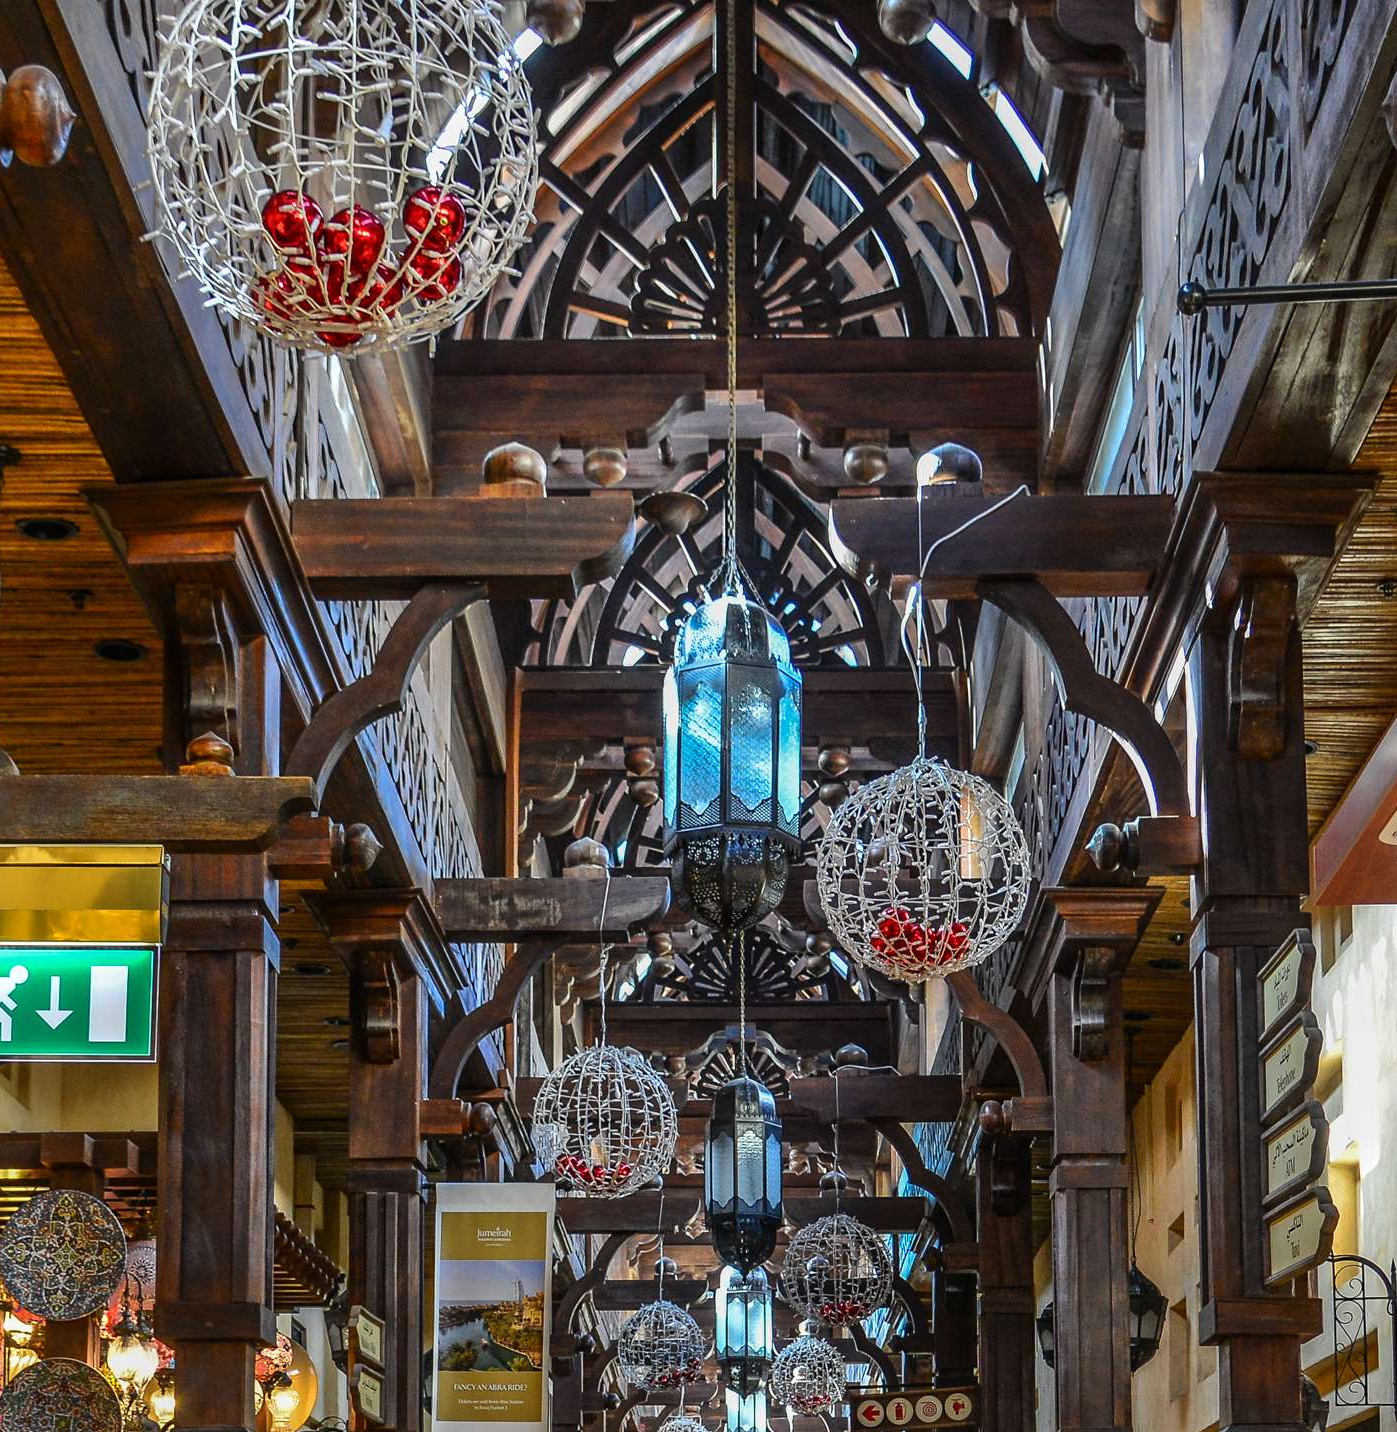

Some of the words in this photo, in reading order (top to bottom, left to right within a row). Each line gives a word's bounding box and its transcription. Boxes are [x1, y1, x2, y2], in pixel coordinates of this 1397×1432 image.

[1276, 1068, 1296, 1094] Telephone
[1285, 1156, 1296, 1177] ATM
[477, 1227, 512, 1238] Jumeirah
[1290, 1240, 1301, 1258] Taxi
[453, 1383, 476, 1391] FANCY
[477, 1383, 487, 1391] AN
[488, 1383, 507, 1391] ABRA
[508, 1383, 528, 1391] RIDE?
